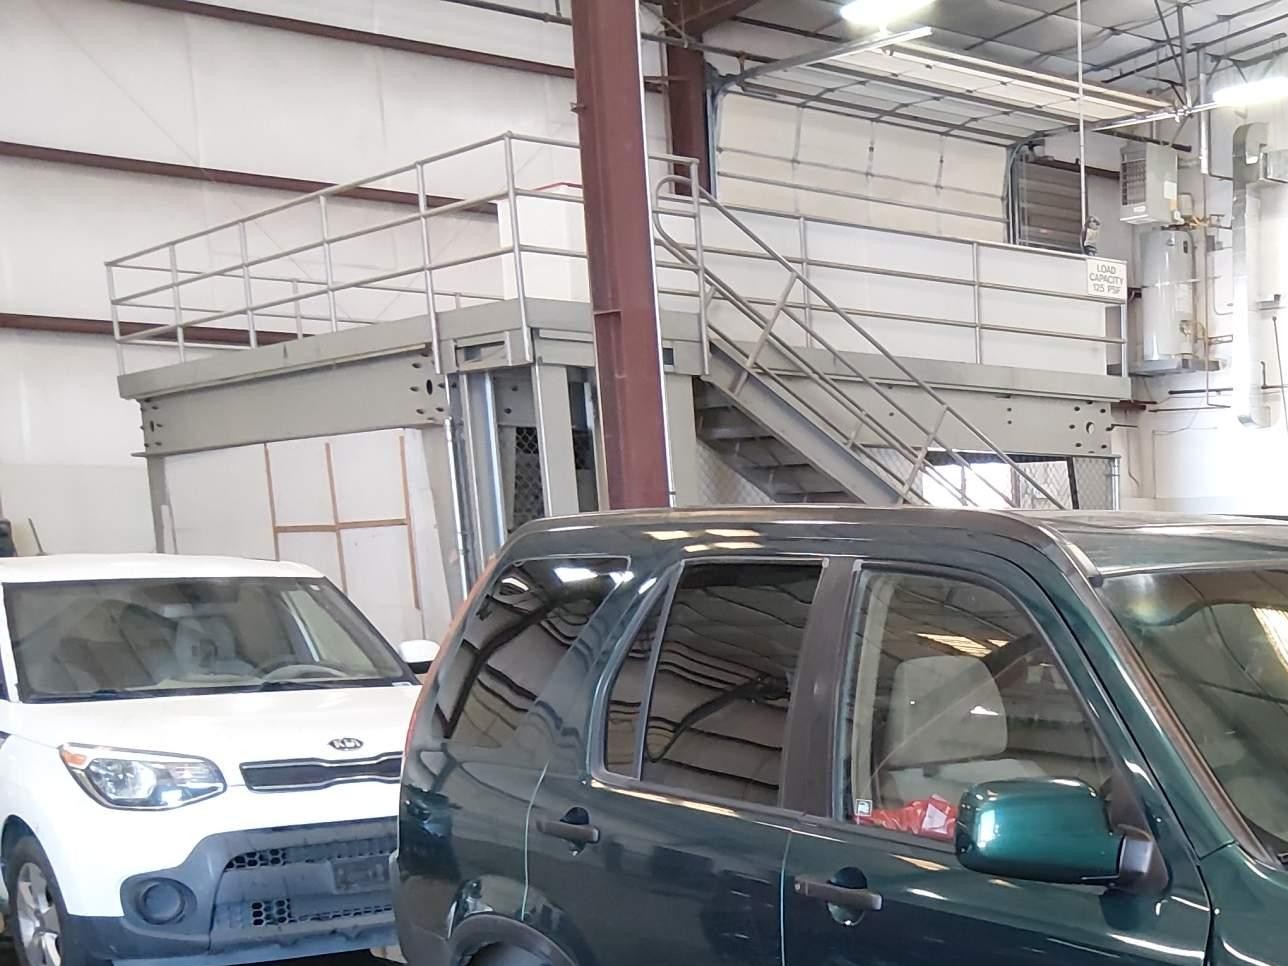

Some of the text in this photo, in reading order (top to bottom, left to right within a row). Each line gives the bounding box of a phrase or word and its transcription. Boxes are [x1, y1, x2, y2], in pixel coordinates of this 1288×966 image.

[1096, 263, 1117, 274] LOAD
[1089, 272, 1124, 286] CAPACITY
[1092, 283, 1105, 292] 125
